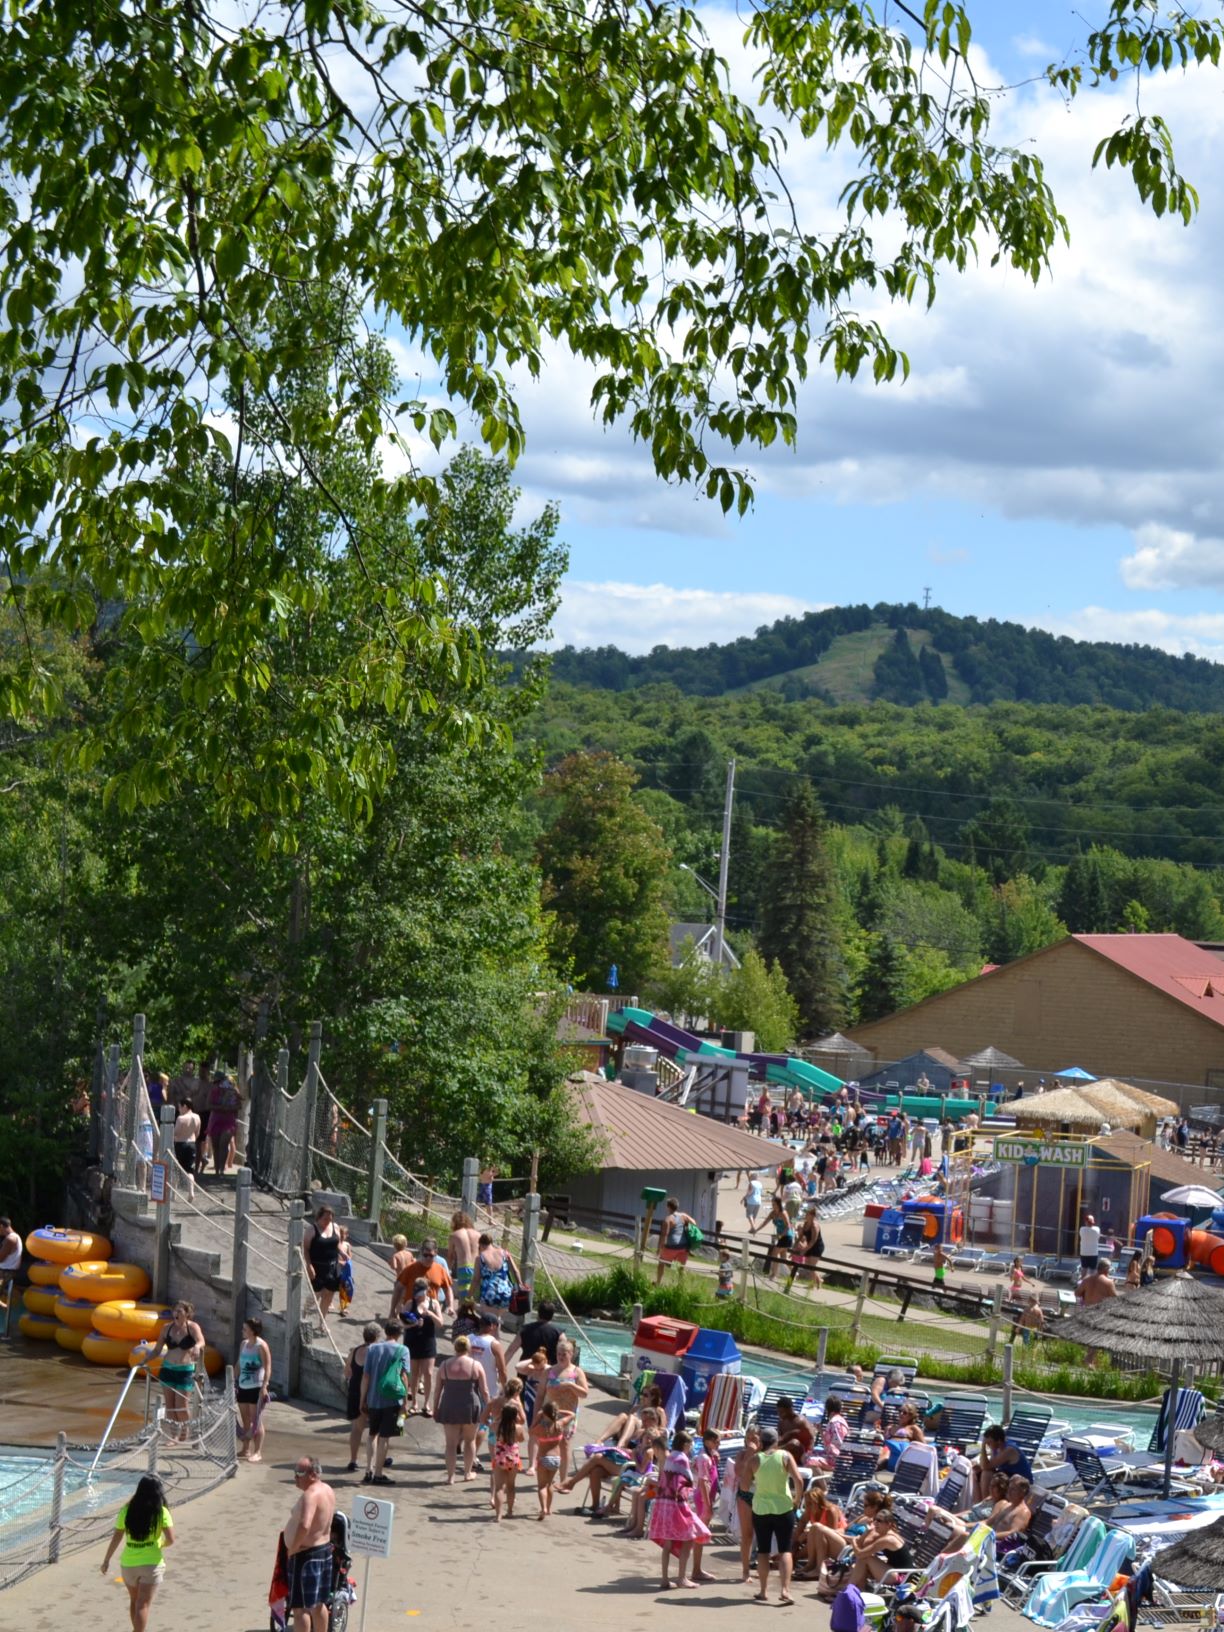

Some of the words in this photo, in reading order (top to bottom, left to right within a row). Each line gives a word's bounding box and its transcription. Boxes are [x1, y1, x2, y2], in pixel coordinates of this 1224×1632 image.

[998, 1143, 1023, 1159] KID
[1039, 1146, 1083, 1163] WASH
[352, 1531, 371, 1541] Smoke
[373, 1535, 386, 1543] Free
